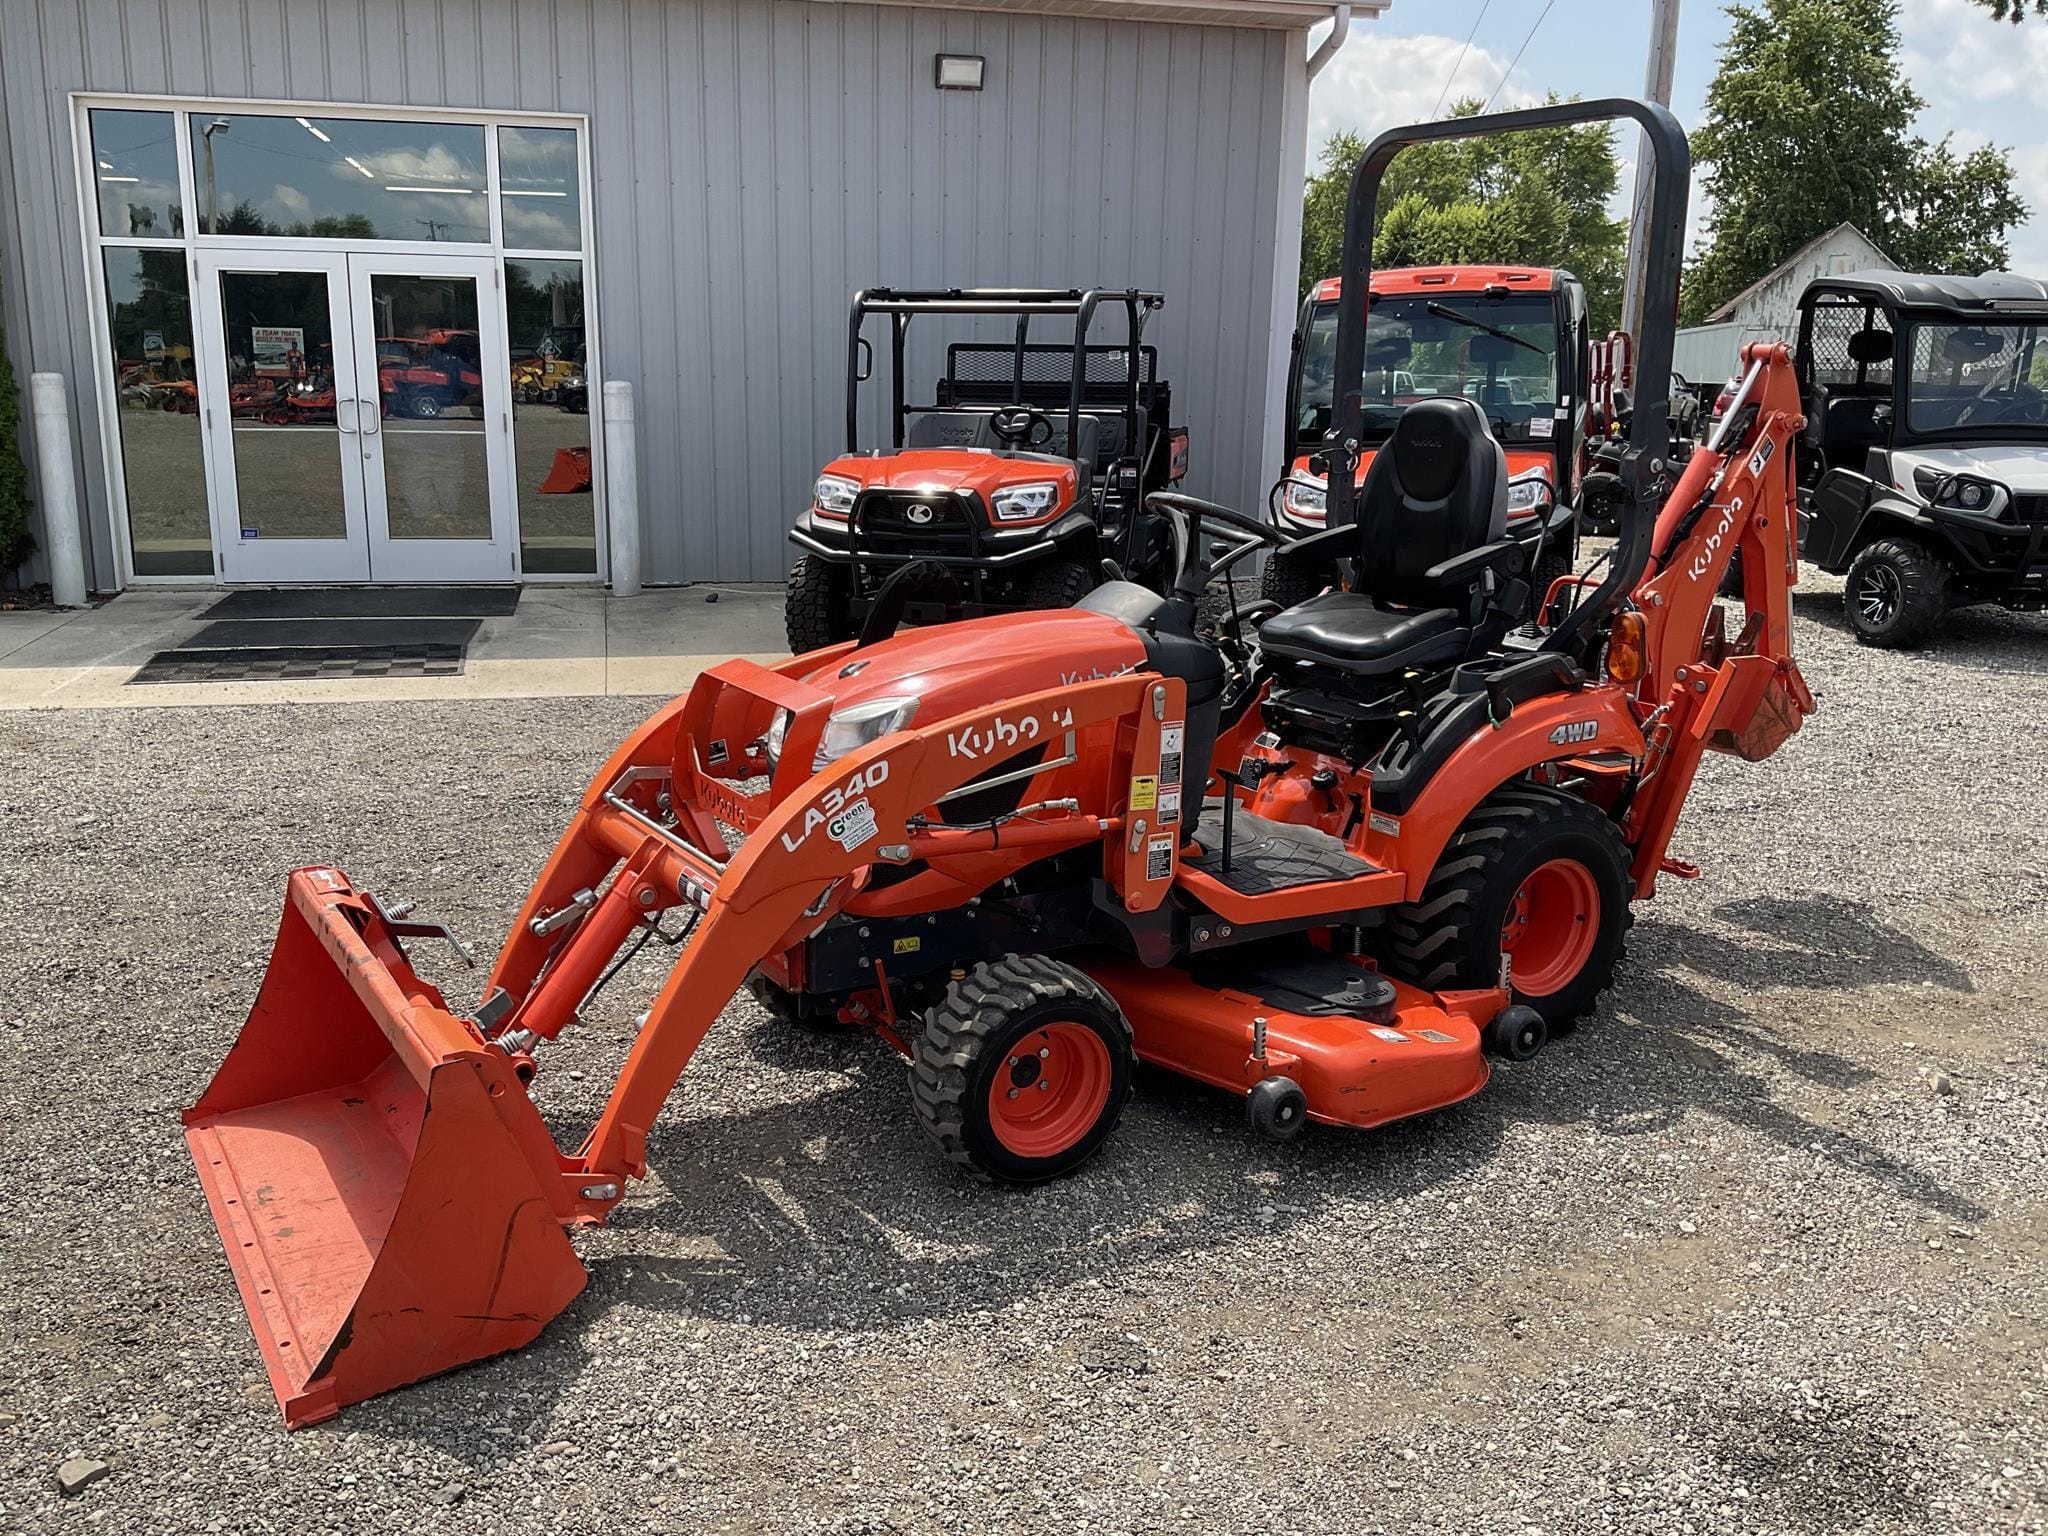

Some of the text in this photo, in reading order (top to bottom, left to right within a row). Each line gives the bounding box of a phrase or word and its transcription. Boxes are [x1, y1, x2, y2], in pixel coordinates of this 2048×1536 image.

[1688, 497, 1743, 581] Kubota
[948, 707, 1073, 759] Kubo
[1549, 720, 1598, 745] 4WD
[781, 760, 889, 852] LA340
[829, 804, 866, 837] Green
